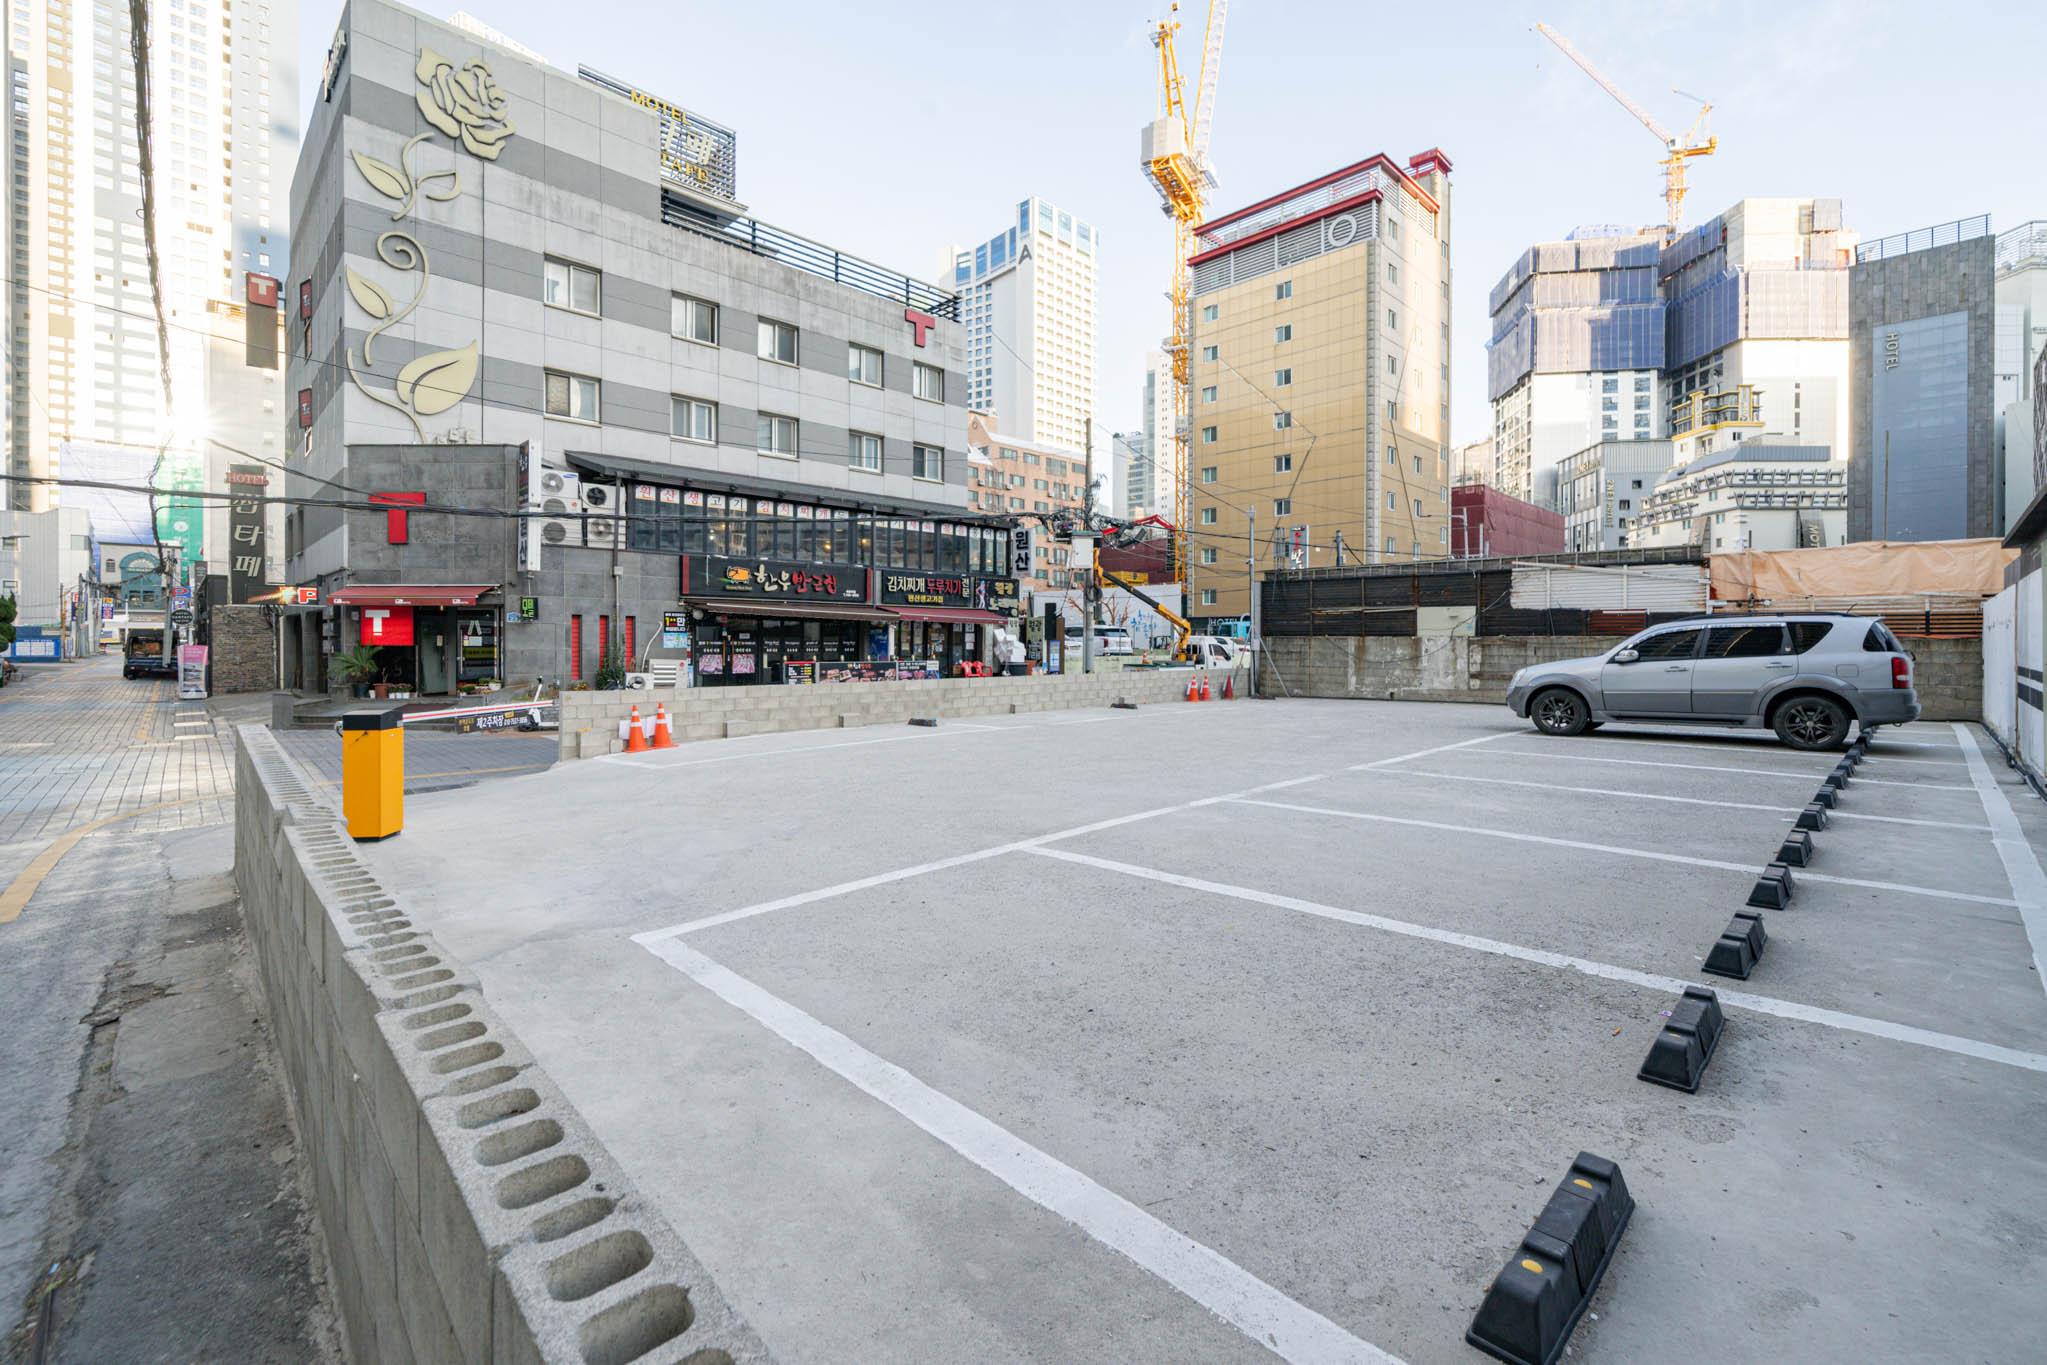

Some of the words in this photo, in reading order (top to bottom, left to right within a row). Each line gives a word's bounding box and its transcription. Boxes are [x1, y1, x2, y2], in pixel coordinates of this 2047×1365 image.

[631, 88, 691, 125] MOTEL
[251, 276, 274, 296] T
[904, 309, 935, 348] T
[1886, 331, 1898, 370] HOTEL
[224, 472, 269, 486] HOTEL
[367, 491, 427, 546] T
[1015, 530, 1029, 571] 원산
[298, 586, 318, 604] P
[887, 576, 925, 592] 김치찌개
[927, 578, 961, 594] 두루치기
